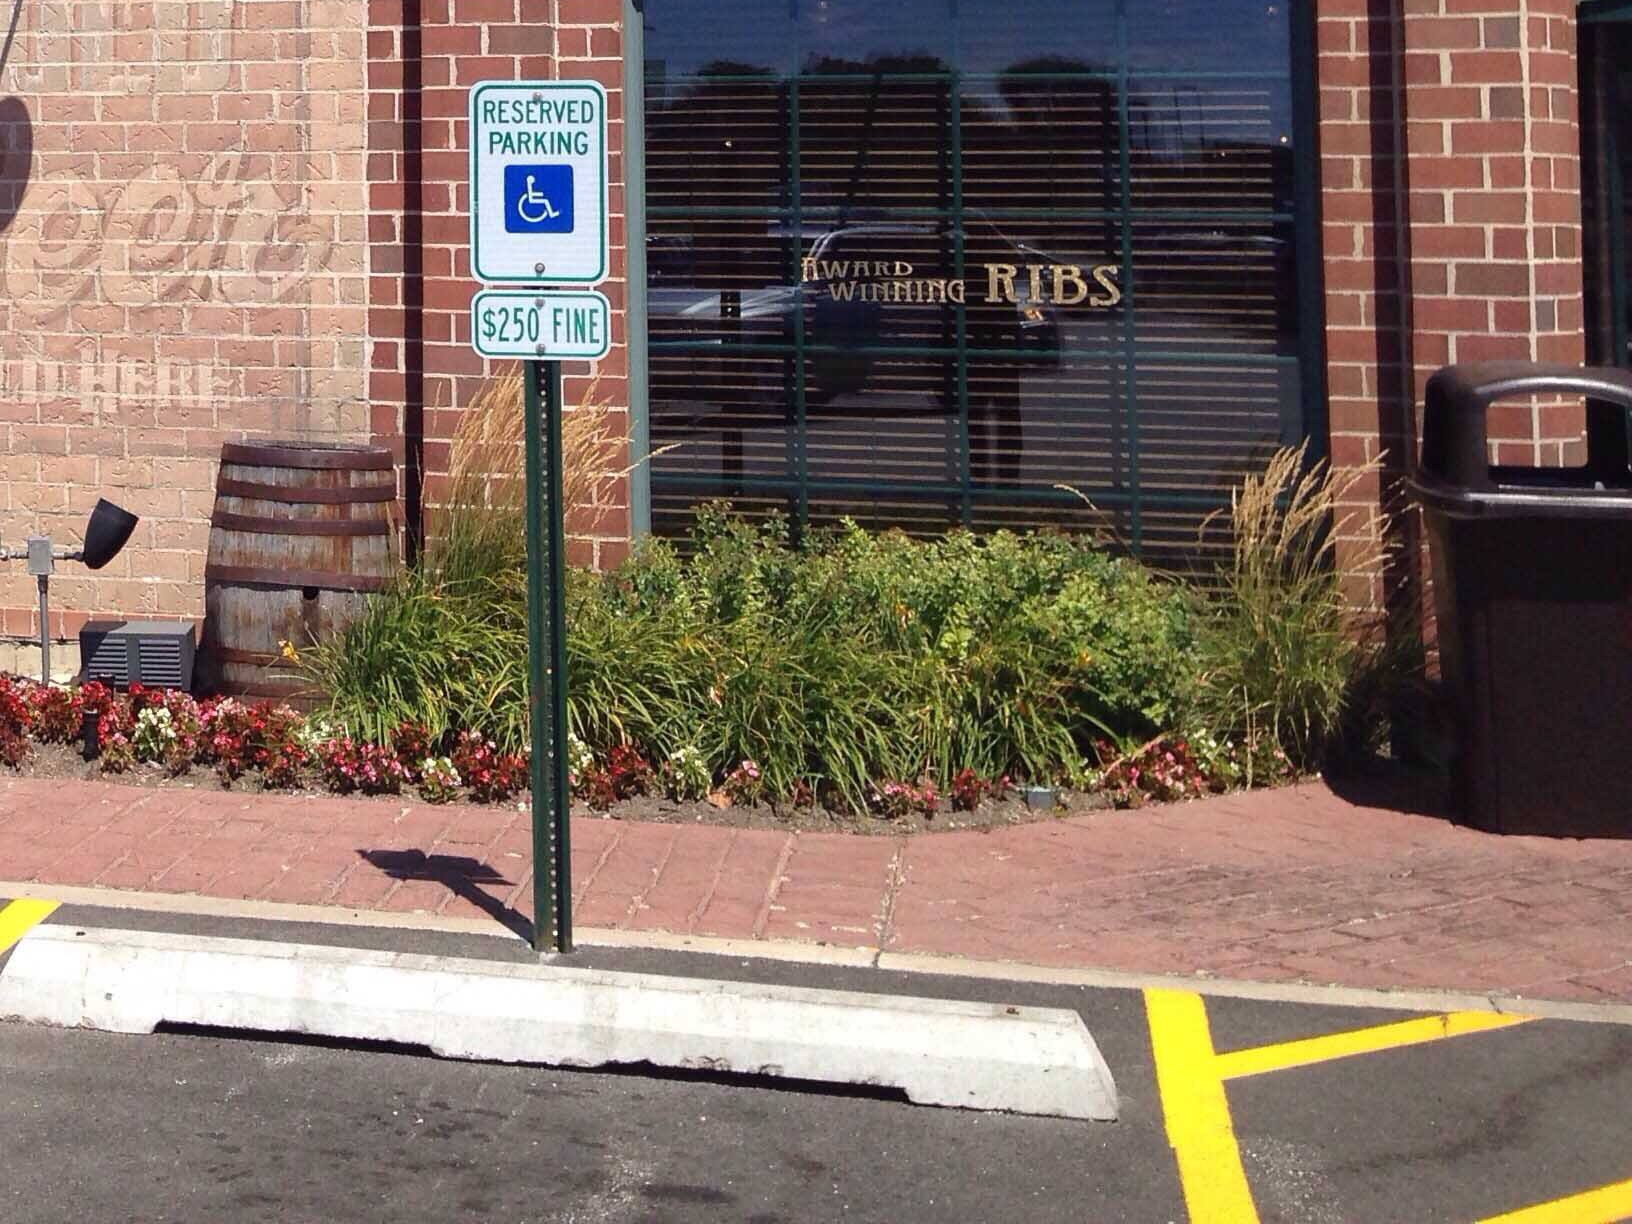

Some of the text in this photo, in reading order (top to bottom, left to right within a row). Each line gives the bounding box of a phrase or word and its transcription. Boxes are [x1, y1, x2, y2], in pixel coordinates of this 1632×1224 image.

[483, 100, 594, 124] RESERVED
[488, 131, 589, 155] PARKING
[801, 257, 913, 282] AWARD
[828, 278, 966, 304] WINNING
[983, 263, 1122, 307] RIBS
[482, 306, 601, 344] $250 FINE
[80, 344, 241, 414] HERE
